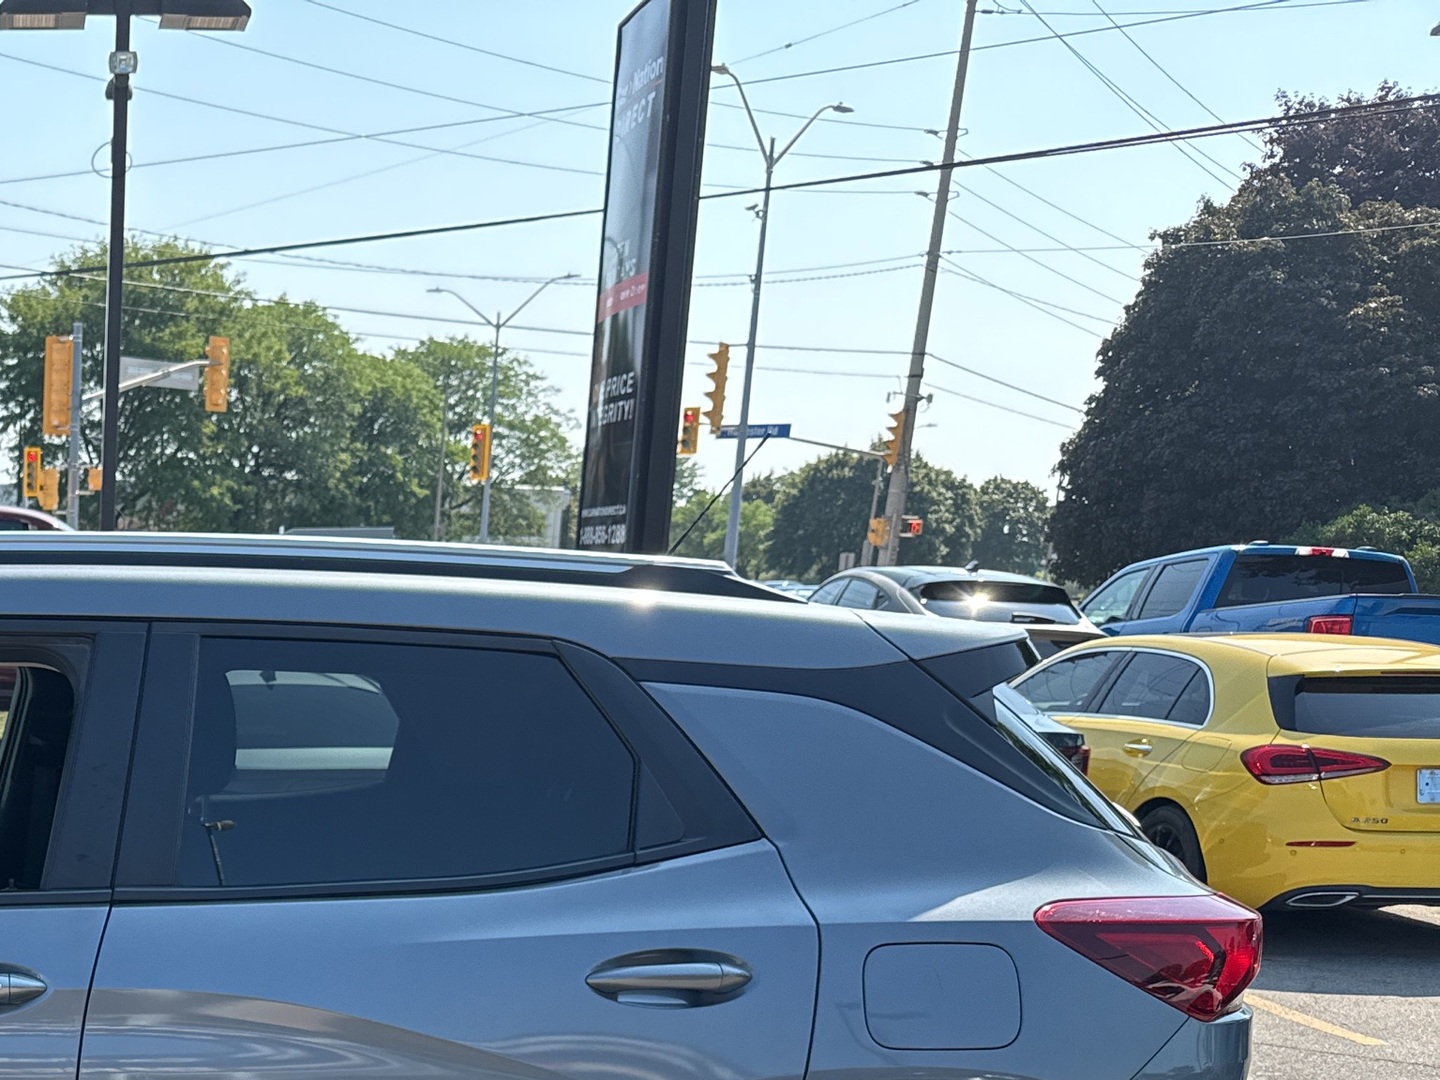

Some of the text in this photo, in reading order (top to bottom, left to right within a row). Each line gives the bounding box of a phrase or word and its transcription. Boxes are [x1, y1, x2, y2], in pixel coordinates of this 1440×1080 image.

[632, 56, 664, 94] Nation
[605, 371, 634, 398] PRICE
[589, 398, 635, 428] NEGRITY!
